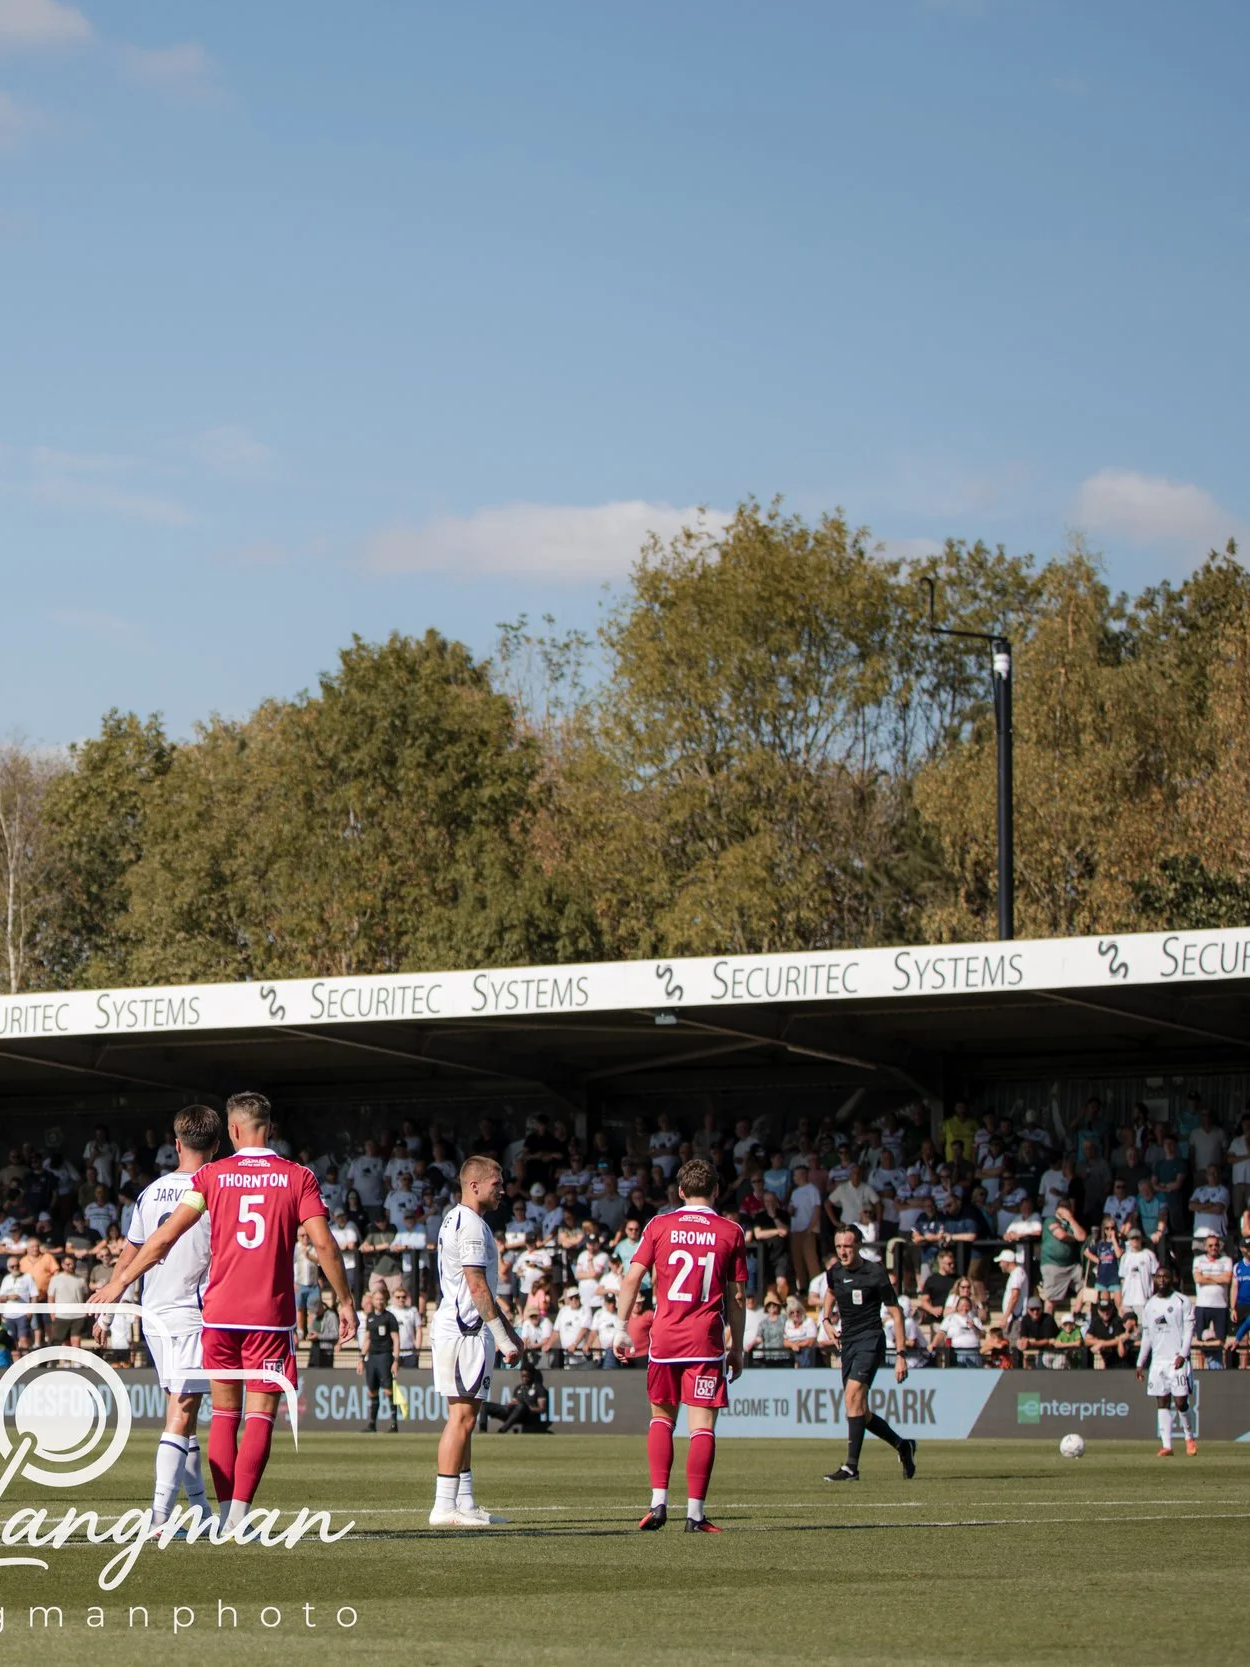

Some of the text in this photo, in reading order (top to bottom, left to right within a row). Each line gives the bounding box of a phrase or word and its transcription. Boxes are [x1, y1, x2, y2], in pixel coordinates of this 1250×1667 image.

[711, 951, 1023, 1000] SECURITEC SYSTEMS
[95, 994, 200, 1029] SYSTEMS
[310, 974, 589, 1019] SECURITEC SYSTEMS
[217, 1173, 289, 1189] THORNTON
[236, 1194, 265, 1249] 5
[670, 1230, 716, 1246] BROWN
[667, 1250, 716, 1303] 21
[698, 1378, 715, 1389] TIG
[720, 1398, 769, 1416] ELCOME
[773, 1398, 789, 1416] TO
[869, 1388, 937, 1425] PARK
[1022, 1398, 1129, 1421] enterprise
